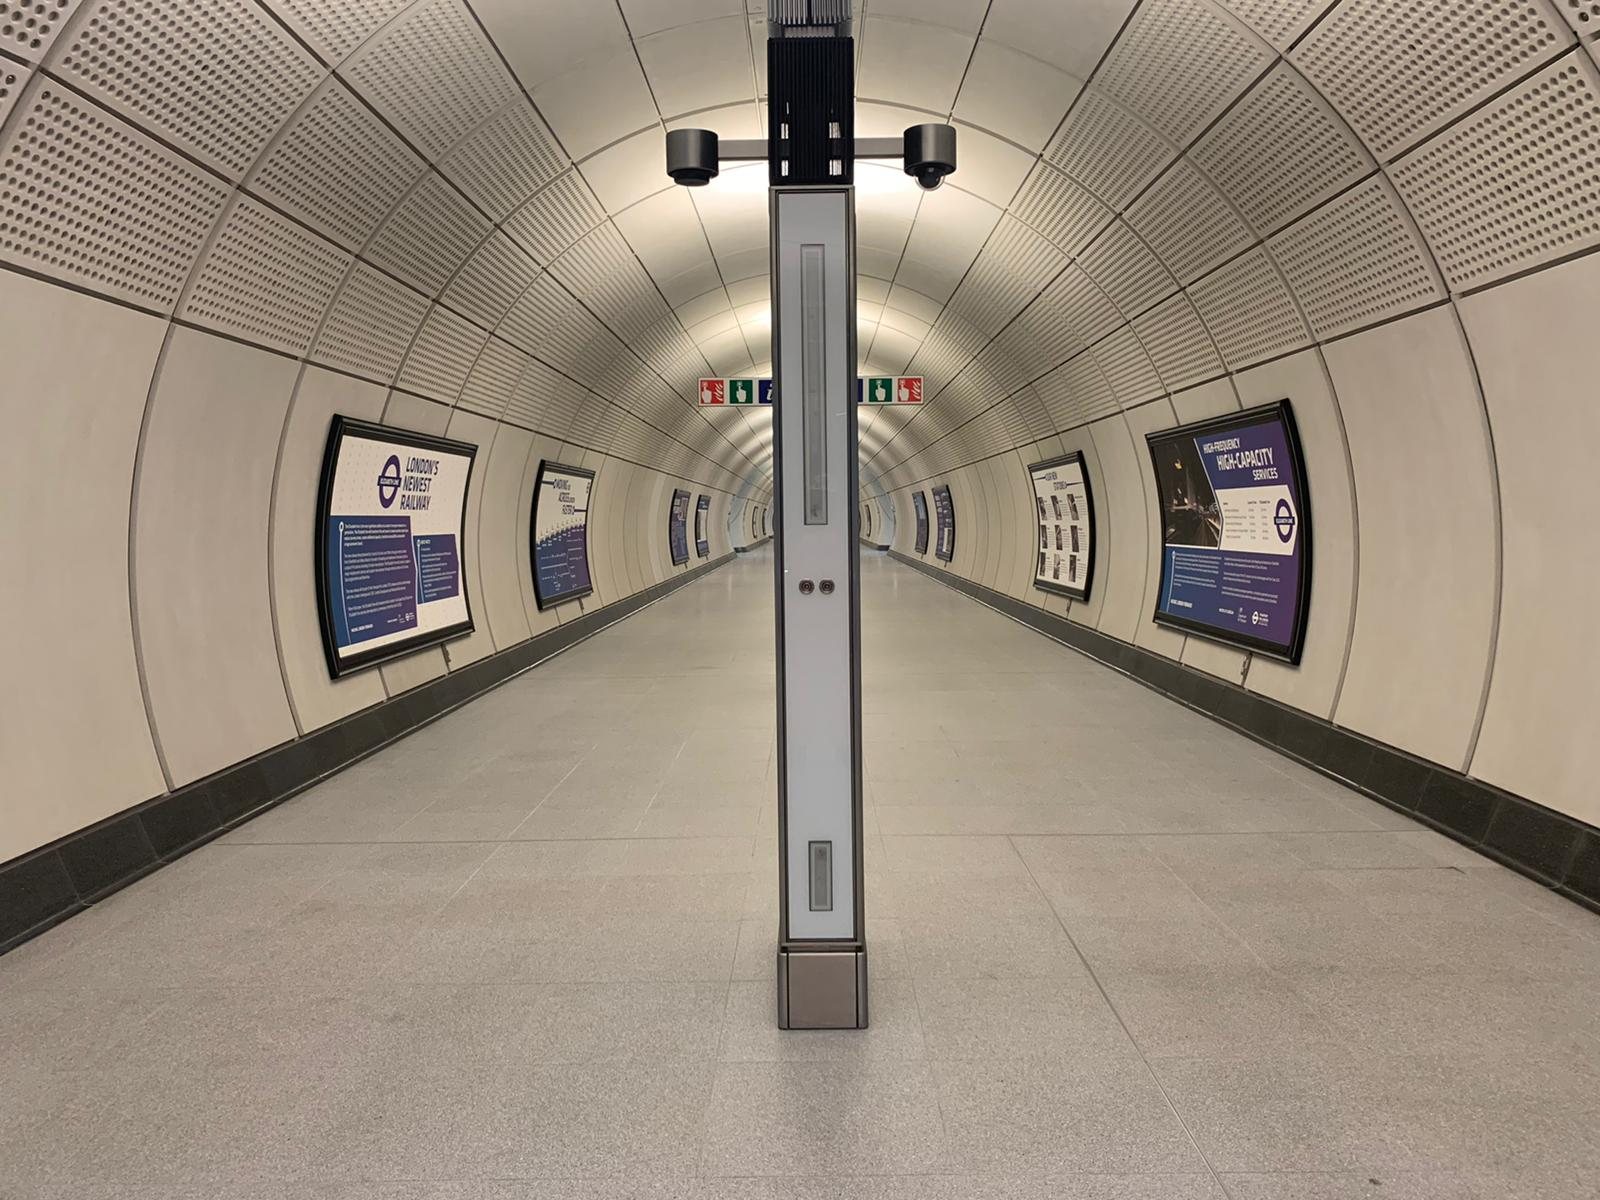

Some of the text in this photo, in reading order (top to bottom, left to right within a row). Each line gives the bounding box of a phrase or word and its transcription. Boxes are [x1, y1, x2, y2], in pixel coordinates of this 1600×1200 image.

[1203, 438, 1241, 454] HIGH-FREQUENCY
[406, 457, 439, 475] LONDON'S
[1216, 447, 1274, 471] HIGH-CAPACITY
[1252, 467, 1279, 481] SERVICES
[403, 475, 432, 492] NEWEST
[400, 494, 431, 510] RAILWAY
